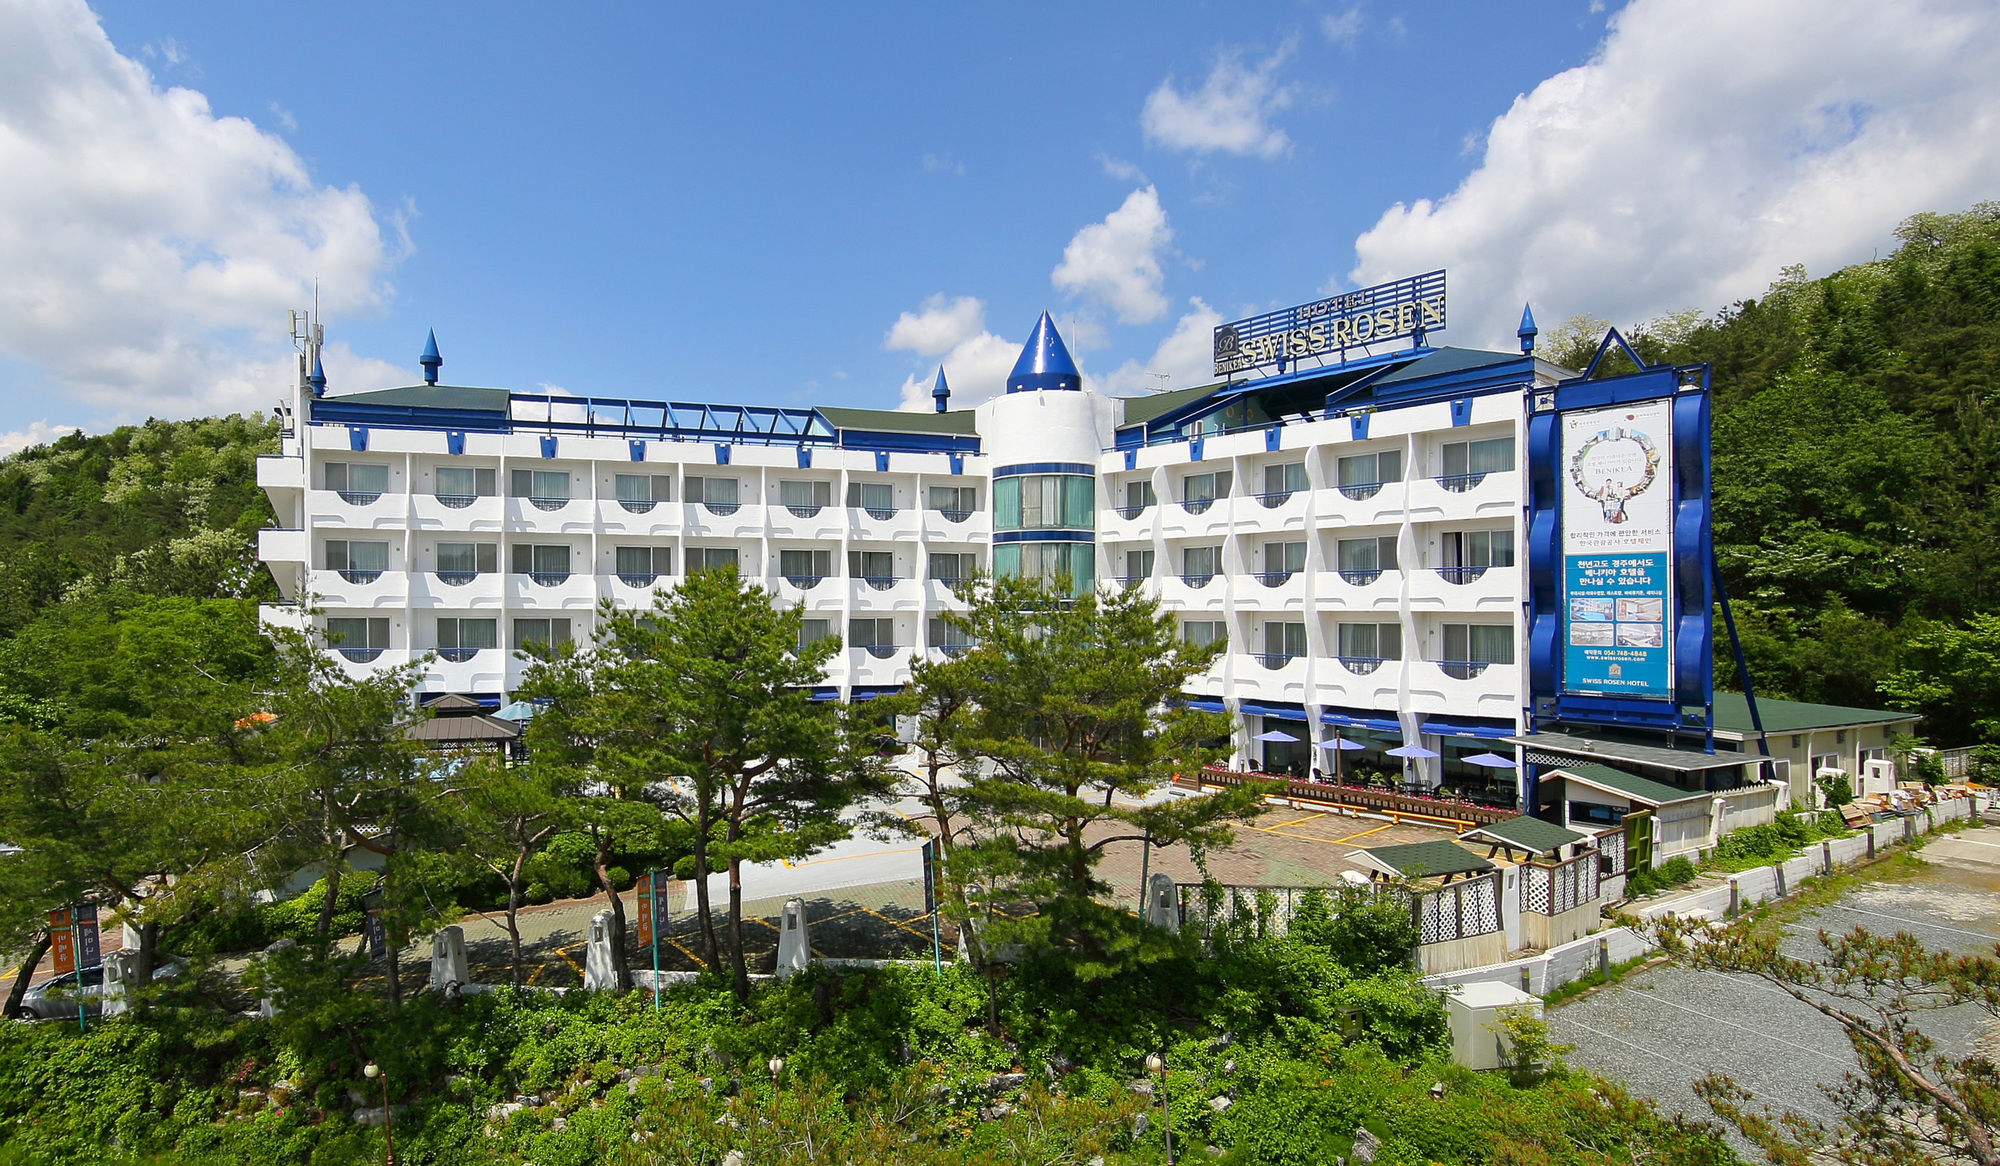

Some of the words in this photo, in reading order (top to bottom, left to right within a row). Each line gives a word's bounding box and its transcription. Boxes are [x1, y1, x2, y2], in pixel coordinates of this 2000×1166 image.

[1300, 291, 1373, 319] HOTEL
[1241, 322, 1326, 365] SWISS
[1332, 295, 1444, 347] ROSEN
[1213, 356, 1243, 375] BENIKEA
[1570, 531, 1596, 539] 합리적인
[1618, 529, 1639, 537] 편안한
[1577, 560, 1609, 568] 천년고도
[1611, 559, 1654, 568] 경주에서도
[1619, 568, 1645, 576] 호텔을
[1579, 578, 1604, 586] 만나실
[1606, 578, 1616, 586] 수
[1617, 577, 1652, 586] 있습니다
[1582, 677, 1602, 685] SWISS
[1626, 680, 1649, 688] HOTEL
